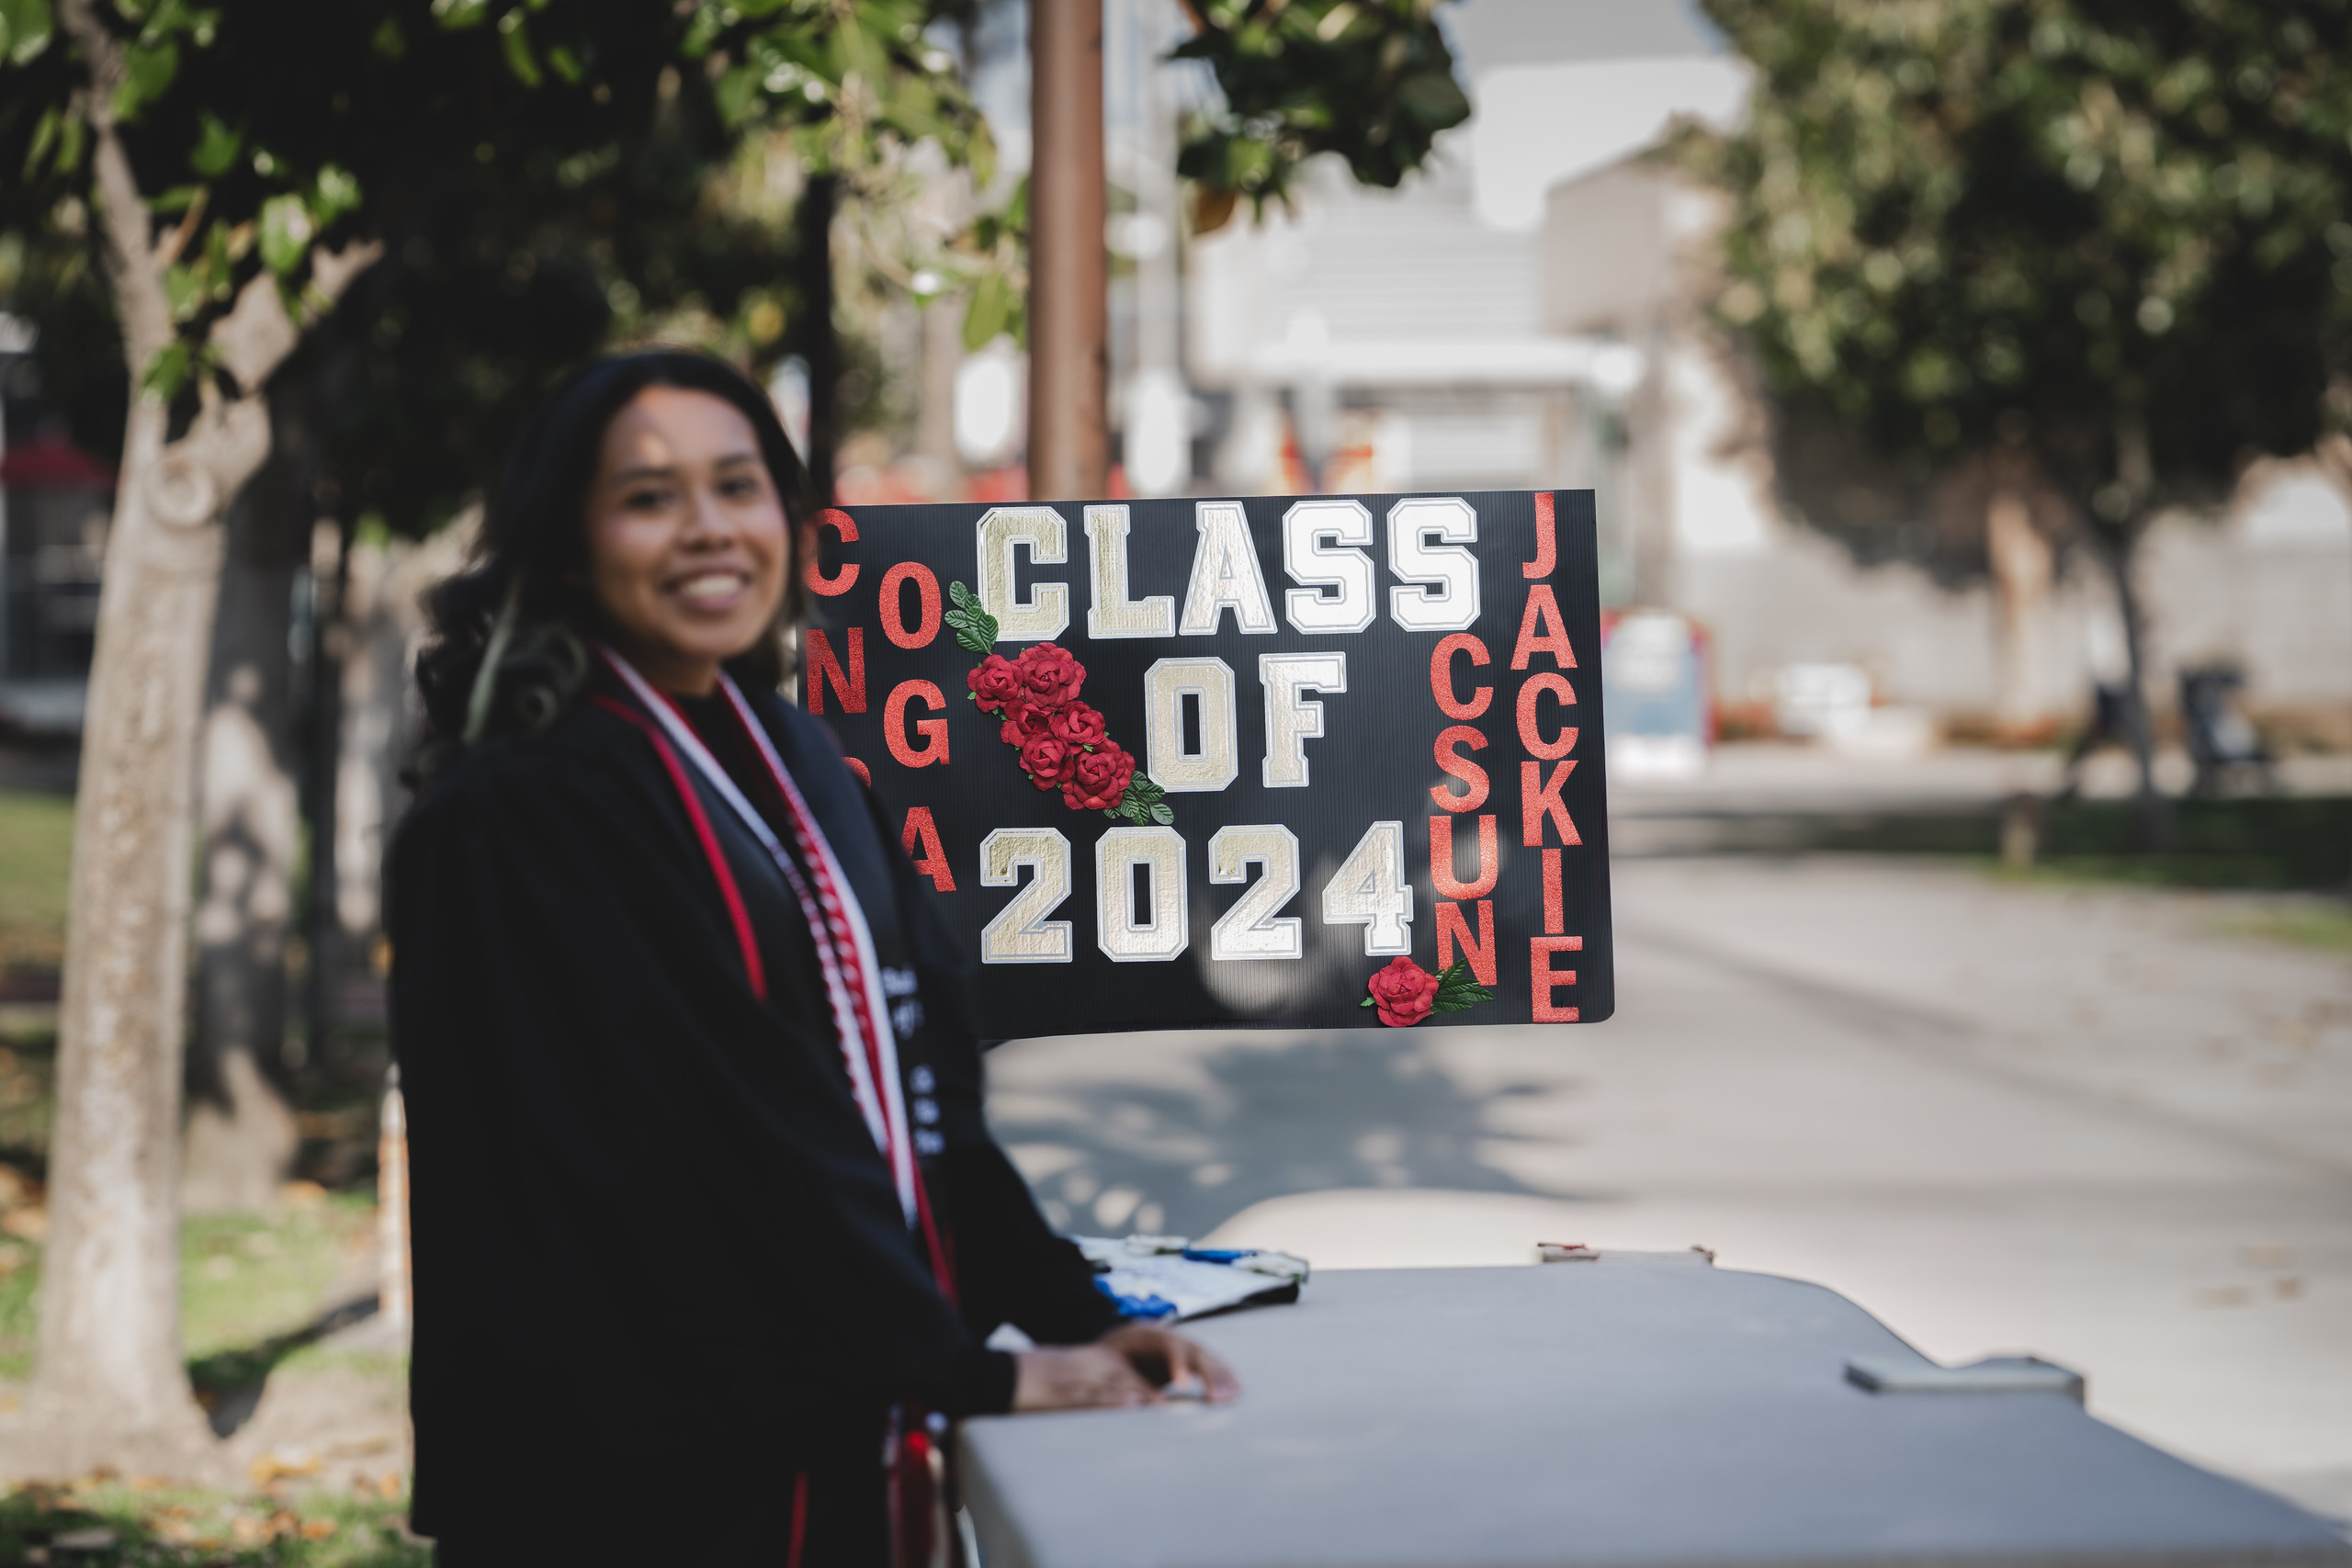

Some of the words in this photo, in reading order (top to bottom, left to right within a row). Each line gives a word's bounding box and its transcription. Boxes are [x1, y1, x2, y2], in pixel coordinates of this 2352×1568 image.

[977, 497, 1479, 641] CLASS
[1145, 651, 1348, 792] OF
[1510, 491, 1584, 1023] JACKIE
[1430, 633, 1499, 987] CSUN
[979, 820, 1414, 964] 2024
